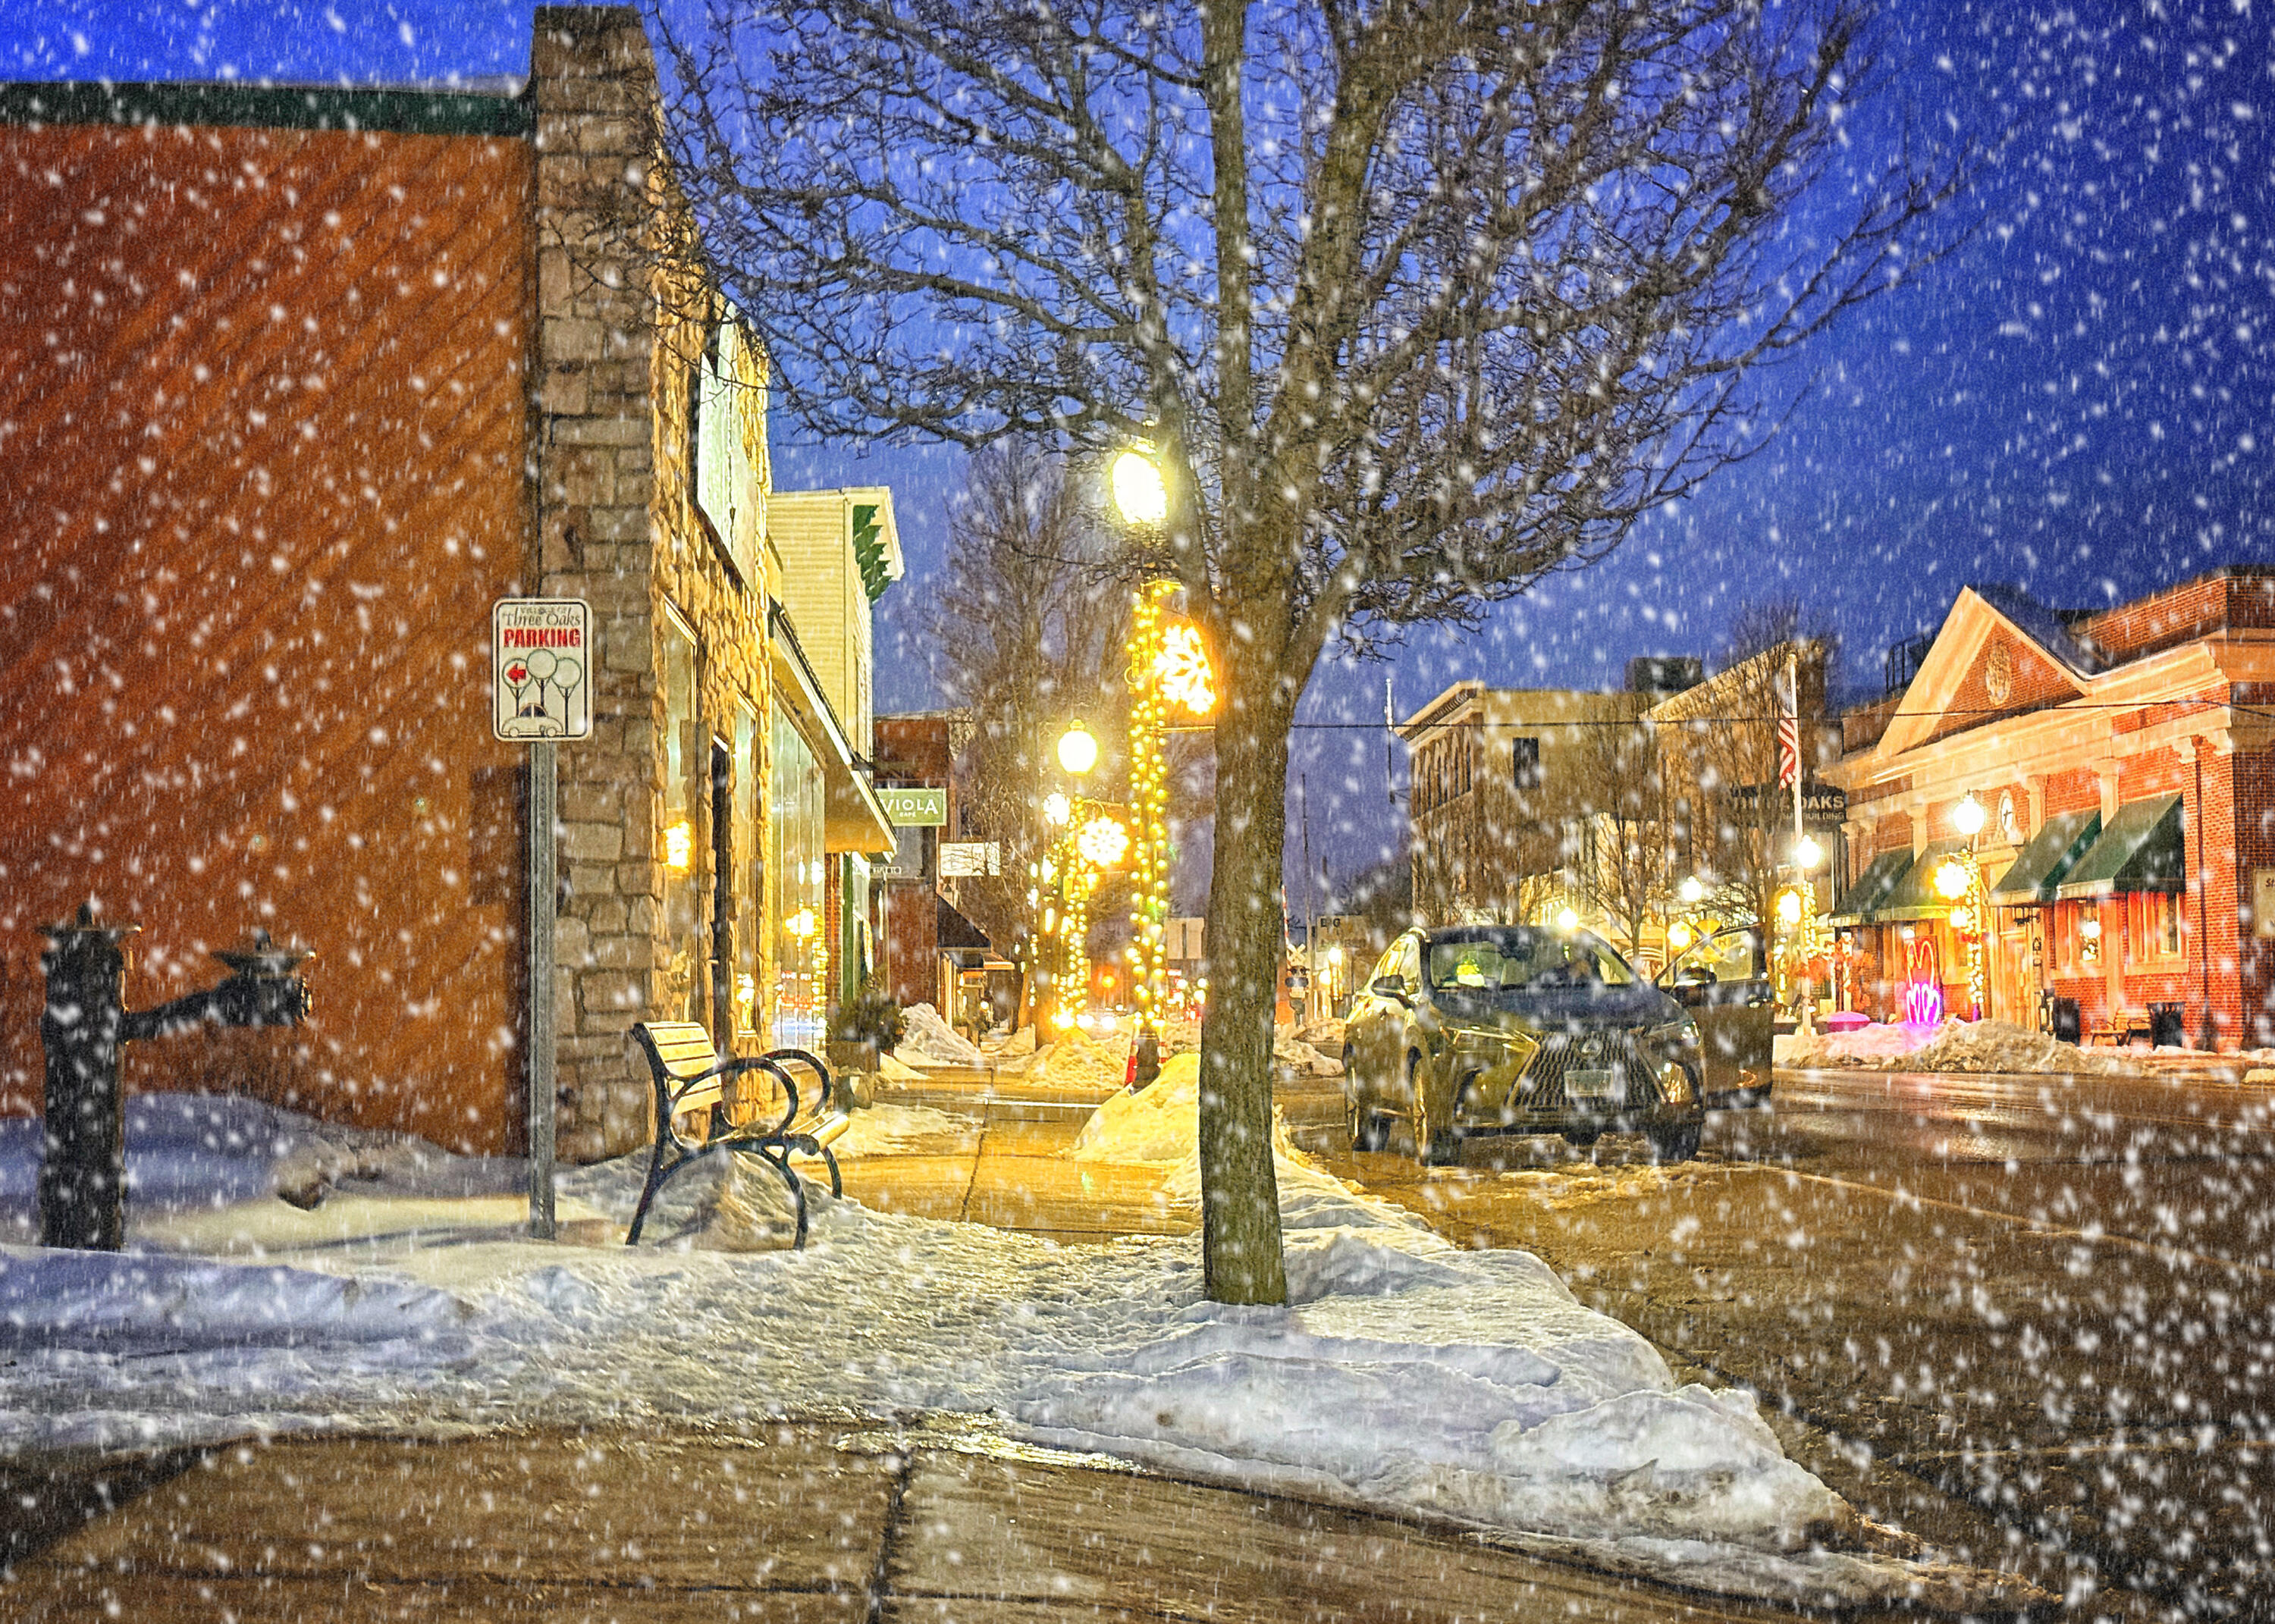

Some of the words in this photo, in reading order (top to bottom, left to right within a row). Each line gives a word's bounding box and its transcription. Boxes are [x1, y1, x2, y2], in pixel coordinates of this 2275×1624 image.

[502, 607, 542, 628] Three
[546, 607, 581, 628] Oaks
[504, 628, 581, 648] PARKING
[880, 798, 939, 815] VIOLA
